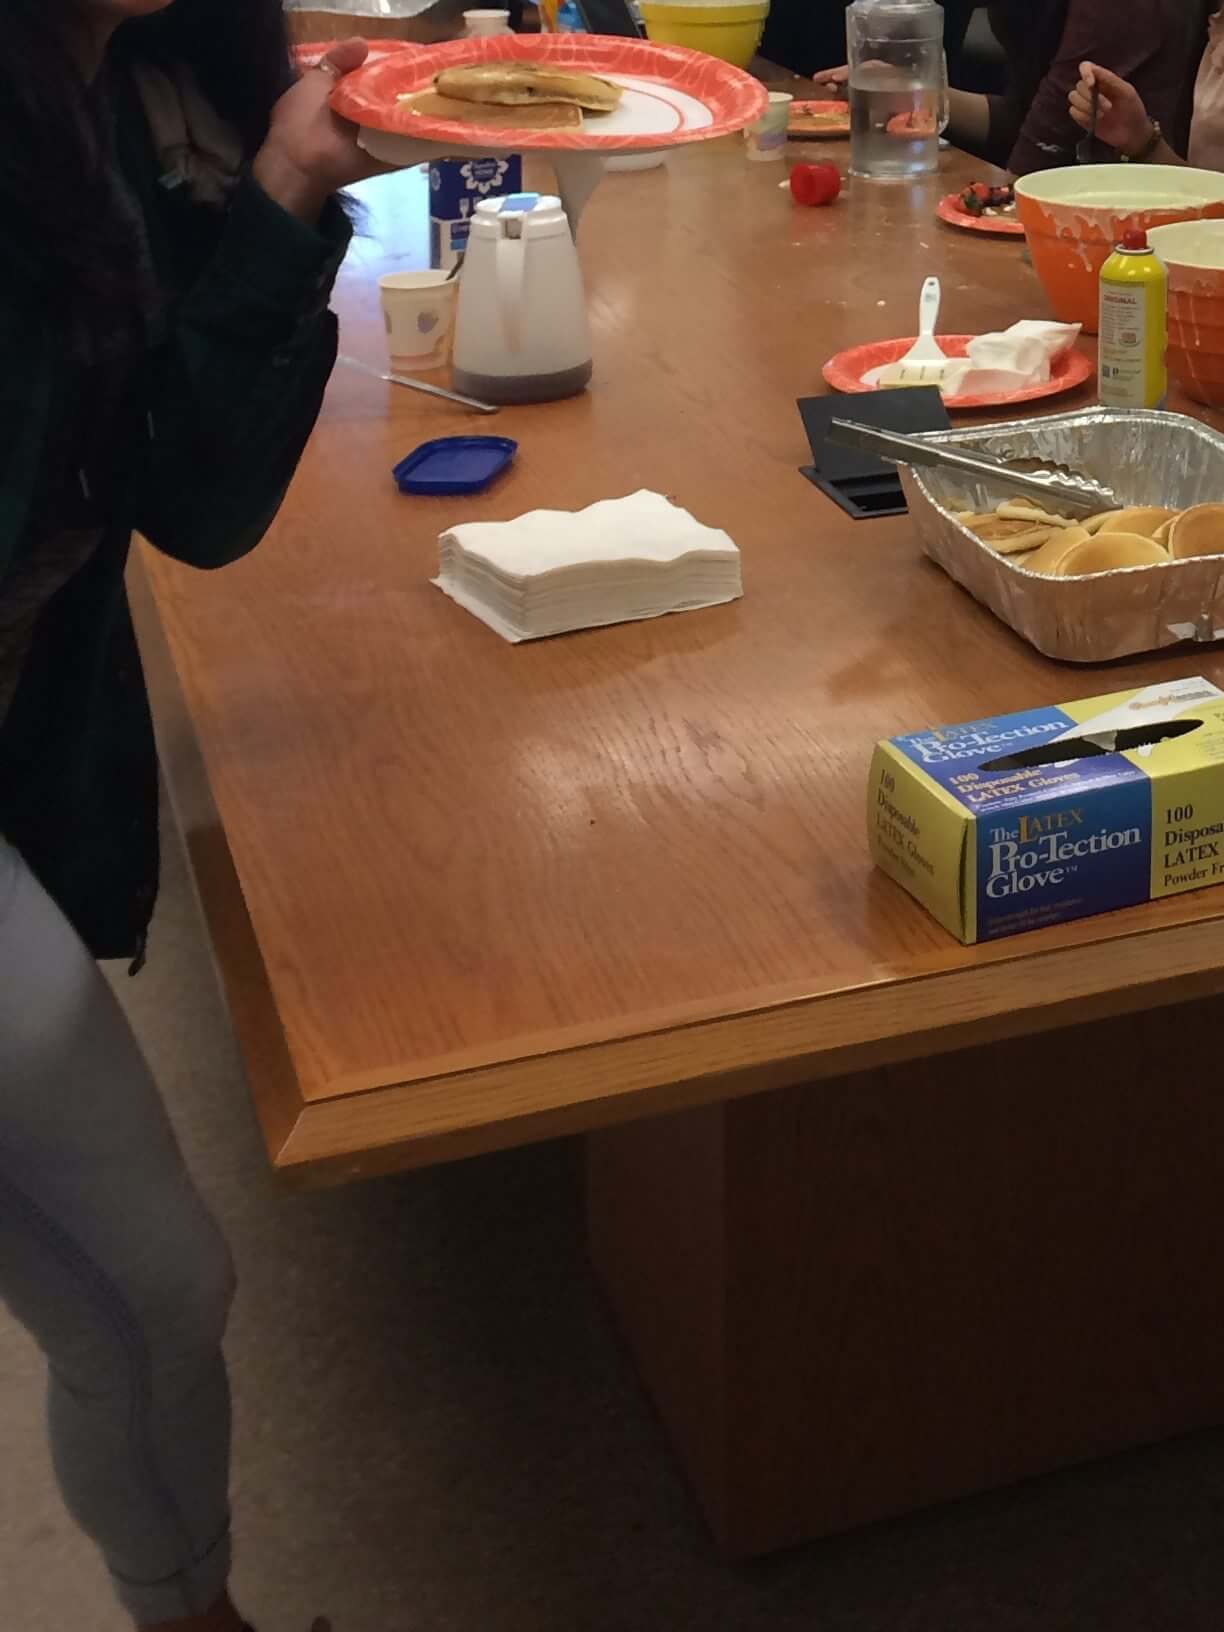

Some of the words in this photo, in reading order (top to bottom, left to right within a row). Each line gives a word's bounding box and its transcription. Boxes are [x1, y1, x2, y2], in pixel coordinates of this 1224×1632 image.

[957, 768, 1042, 794] Disposable
[966, 783, 1026, 804] LATEX
[1028, 772, 1082, 788] Gloves
[989, 826, 1019, 843] The
[1018, 807, 1084, 844] LATEX
[1165, 804, 1195, 825] 100
[987, 828, 1143, 879] Pro-Tection
[1164, 841, 1220, 869] LATEX
[1163, 868, 1209, 887] Powder
